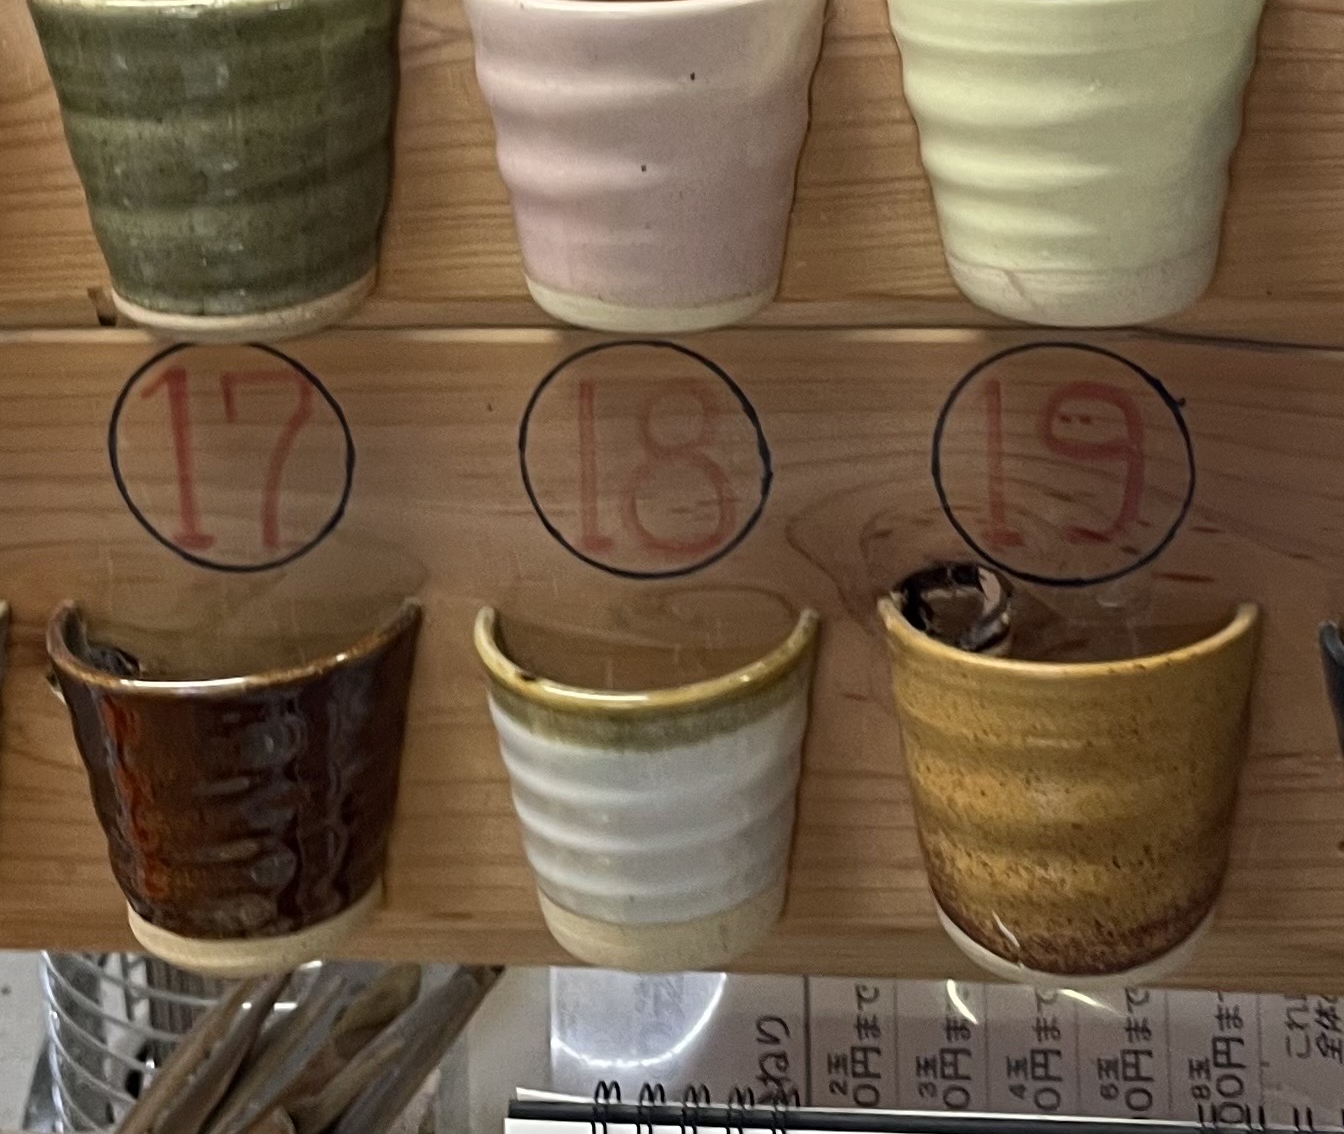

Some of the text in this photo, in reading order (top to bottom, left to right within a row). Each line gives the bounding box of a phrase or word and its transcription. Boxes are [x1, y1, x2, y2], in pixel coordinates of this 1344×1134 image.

[140, 367, 314, 551] 17
[576, 375, 736, 557] 18
[981, 378, 1146, 549] 19
